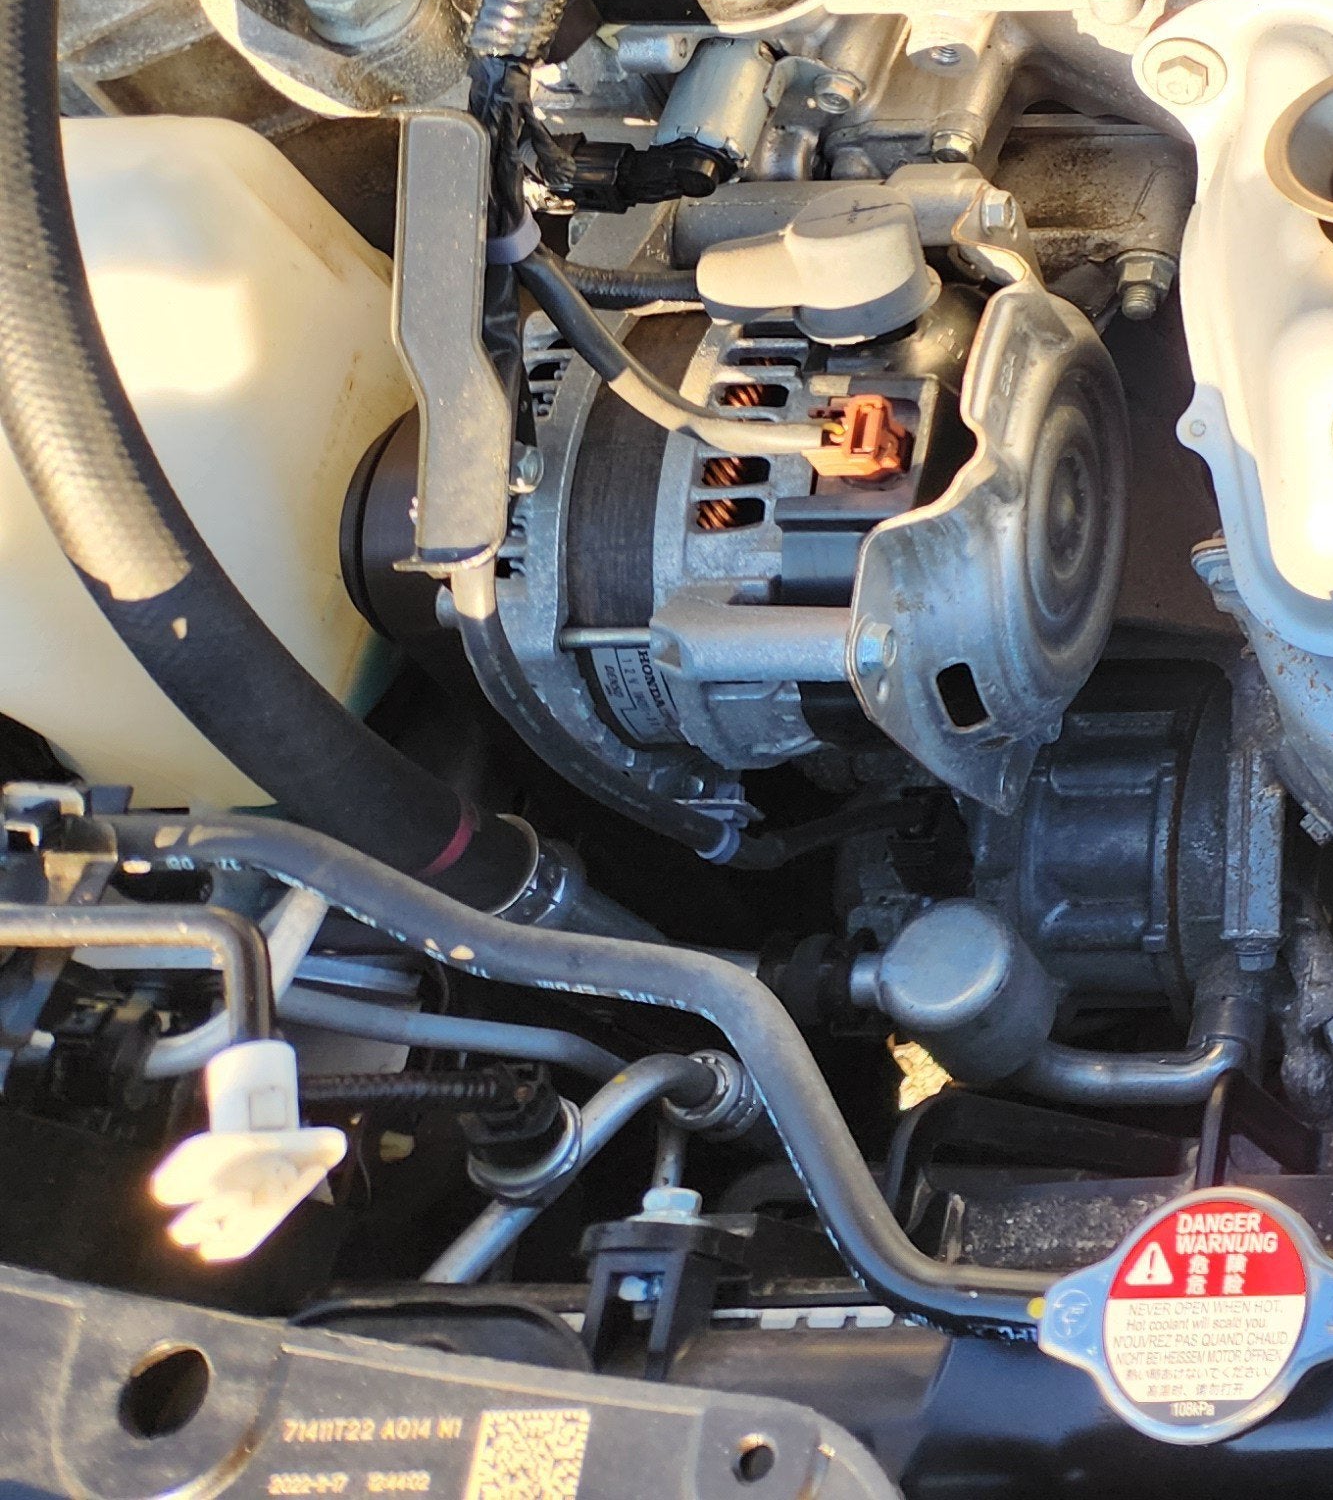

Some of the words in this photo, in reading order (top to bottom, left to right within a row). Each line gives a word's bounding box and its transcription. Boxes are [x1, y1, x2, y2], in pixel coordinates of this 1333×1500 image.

[637, 649, 666, 709] HONDA
[1176, 1212, 1262, 1234] DANGER
[1174, 1231, 1279, 1255] WARNUNG
[1128, 1302, 1171, 1317] NEVER
[1174, 1301, 1210, 1316] OPEN
[1212, 1300, 1252, 1315] WHEN
[1126, 1319, 1146, 1332] Hot
[1148, 1318, 1190, 1332] coolant
[1191, 1317, 1209, 1330] will
[1211, 1316, 1242, 1329] scald
[1175, 1333, 1199, 1348] PAS
[1201, 1332, 1246, 1348] QUAND
[1246, 1330, 1289, 1346] CHAUD
[1115, 1351, 1144, 1367] NICHT
[1145, 1351, 1162, 1366] BEI
[1163, 1350, 1205, 1365] HEISSEM
[1207, 1349, 1242, 1364] MOTOR
[1169, 1401, 1216, 1418] 108kPa
